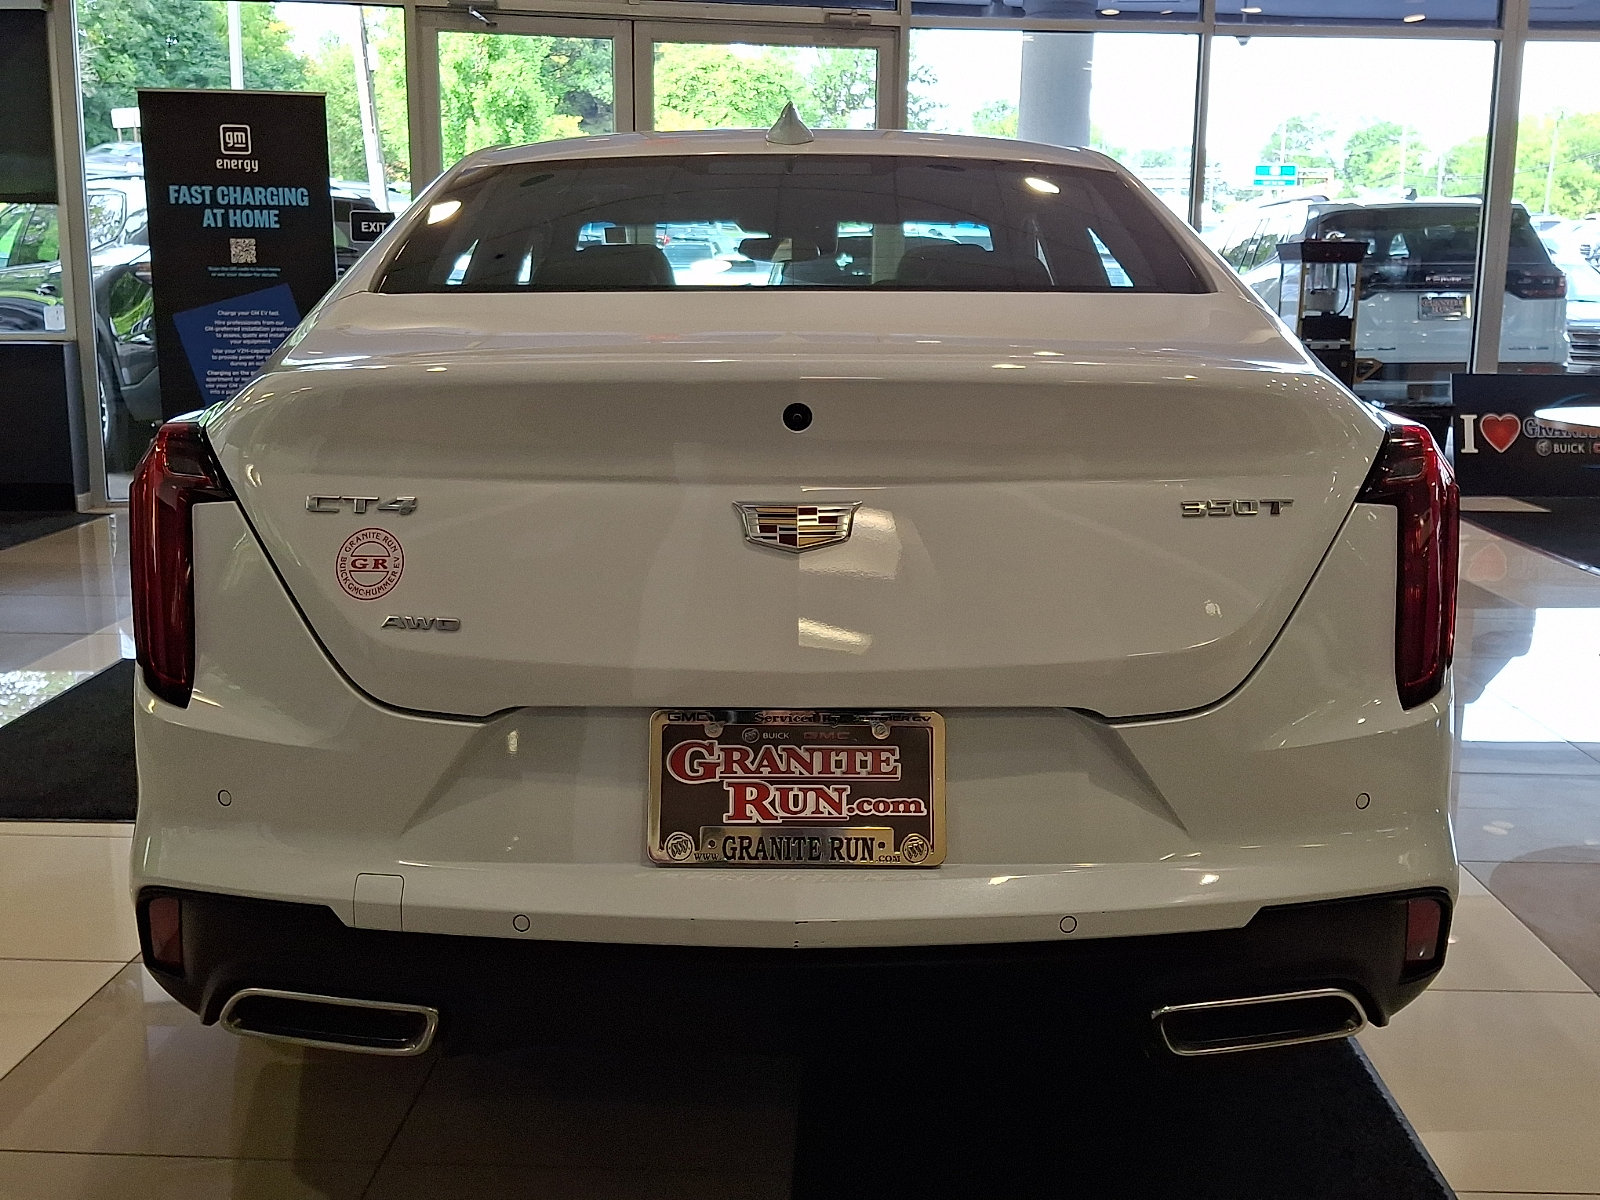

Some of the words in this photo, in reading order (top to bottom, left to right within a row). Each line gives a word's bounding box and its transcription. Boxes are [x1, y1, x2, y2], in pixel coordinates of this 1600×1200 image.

[225, 131, 246, 147] gm
[216, 158, 259, 172] energy
[168, 185, 213, 205] FAST
[216, 186, 309, 206] CHARGING
[202, 208, 225, 228] AT
[228, 209, 280, 228] HOME
[361, 221, 387, 232] EXIT
[1460, 414, 1479, 453] I
[1553, 443, 1585, 454] BUICK
[305, 495, 417, 515] CT4
[1181, 498, 1294, 517] 350T
[344, 532, 381, 553] GRANITE
[382, 535, 398, 553] RUN
[340, 556, 350, 585] BUICK
[393, 556, 400, 569] EV
[381, 615, 461, 631] AWD
[754, 711, 816, 723] Serviced
[803, 731, 850, 739] GMC
[666, 740, 901, 784] GRANITE
[723, 780, 928, 824] RUN.com
[721, 835, 823, 861] GRANITE
[828, 836, 875, 862] RUN
